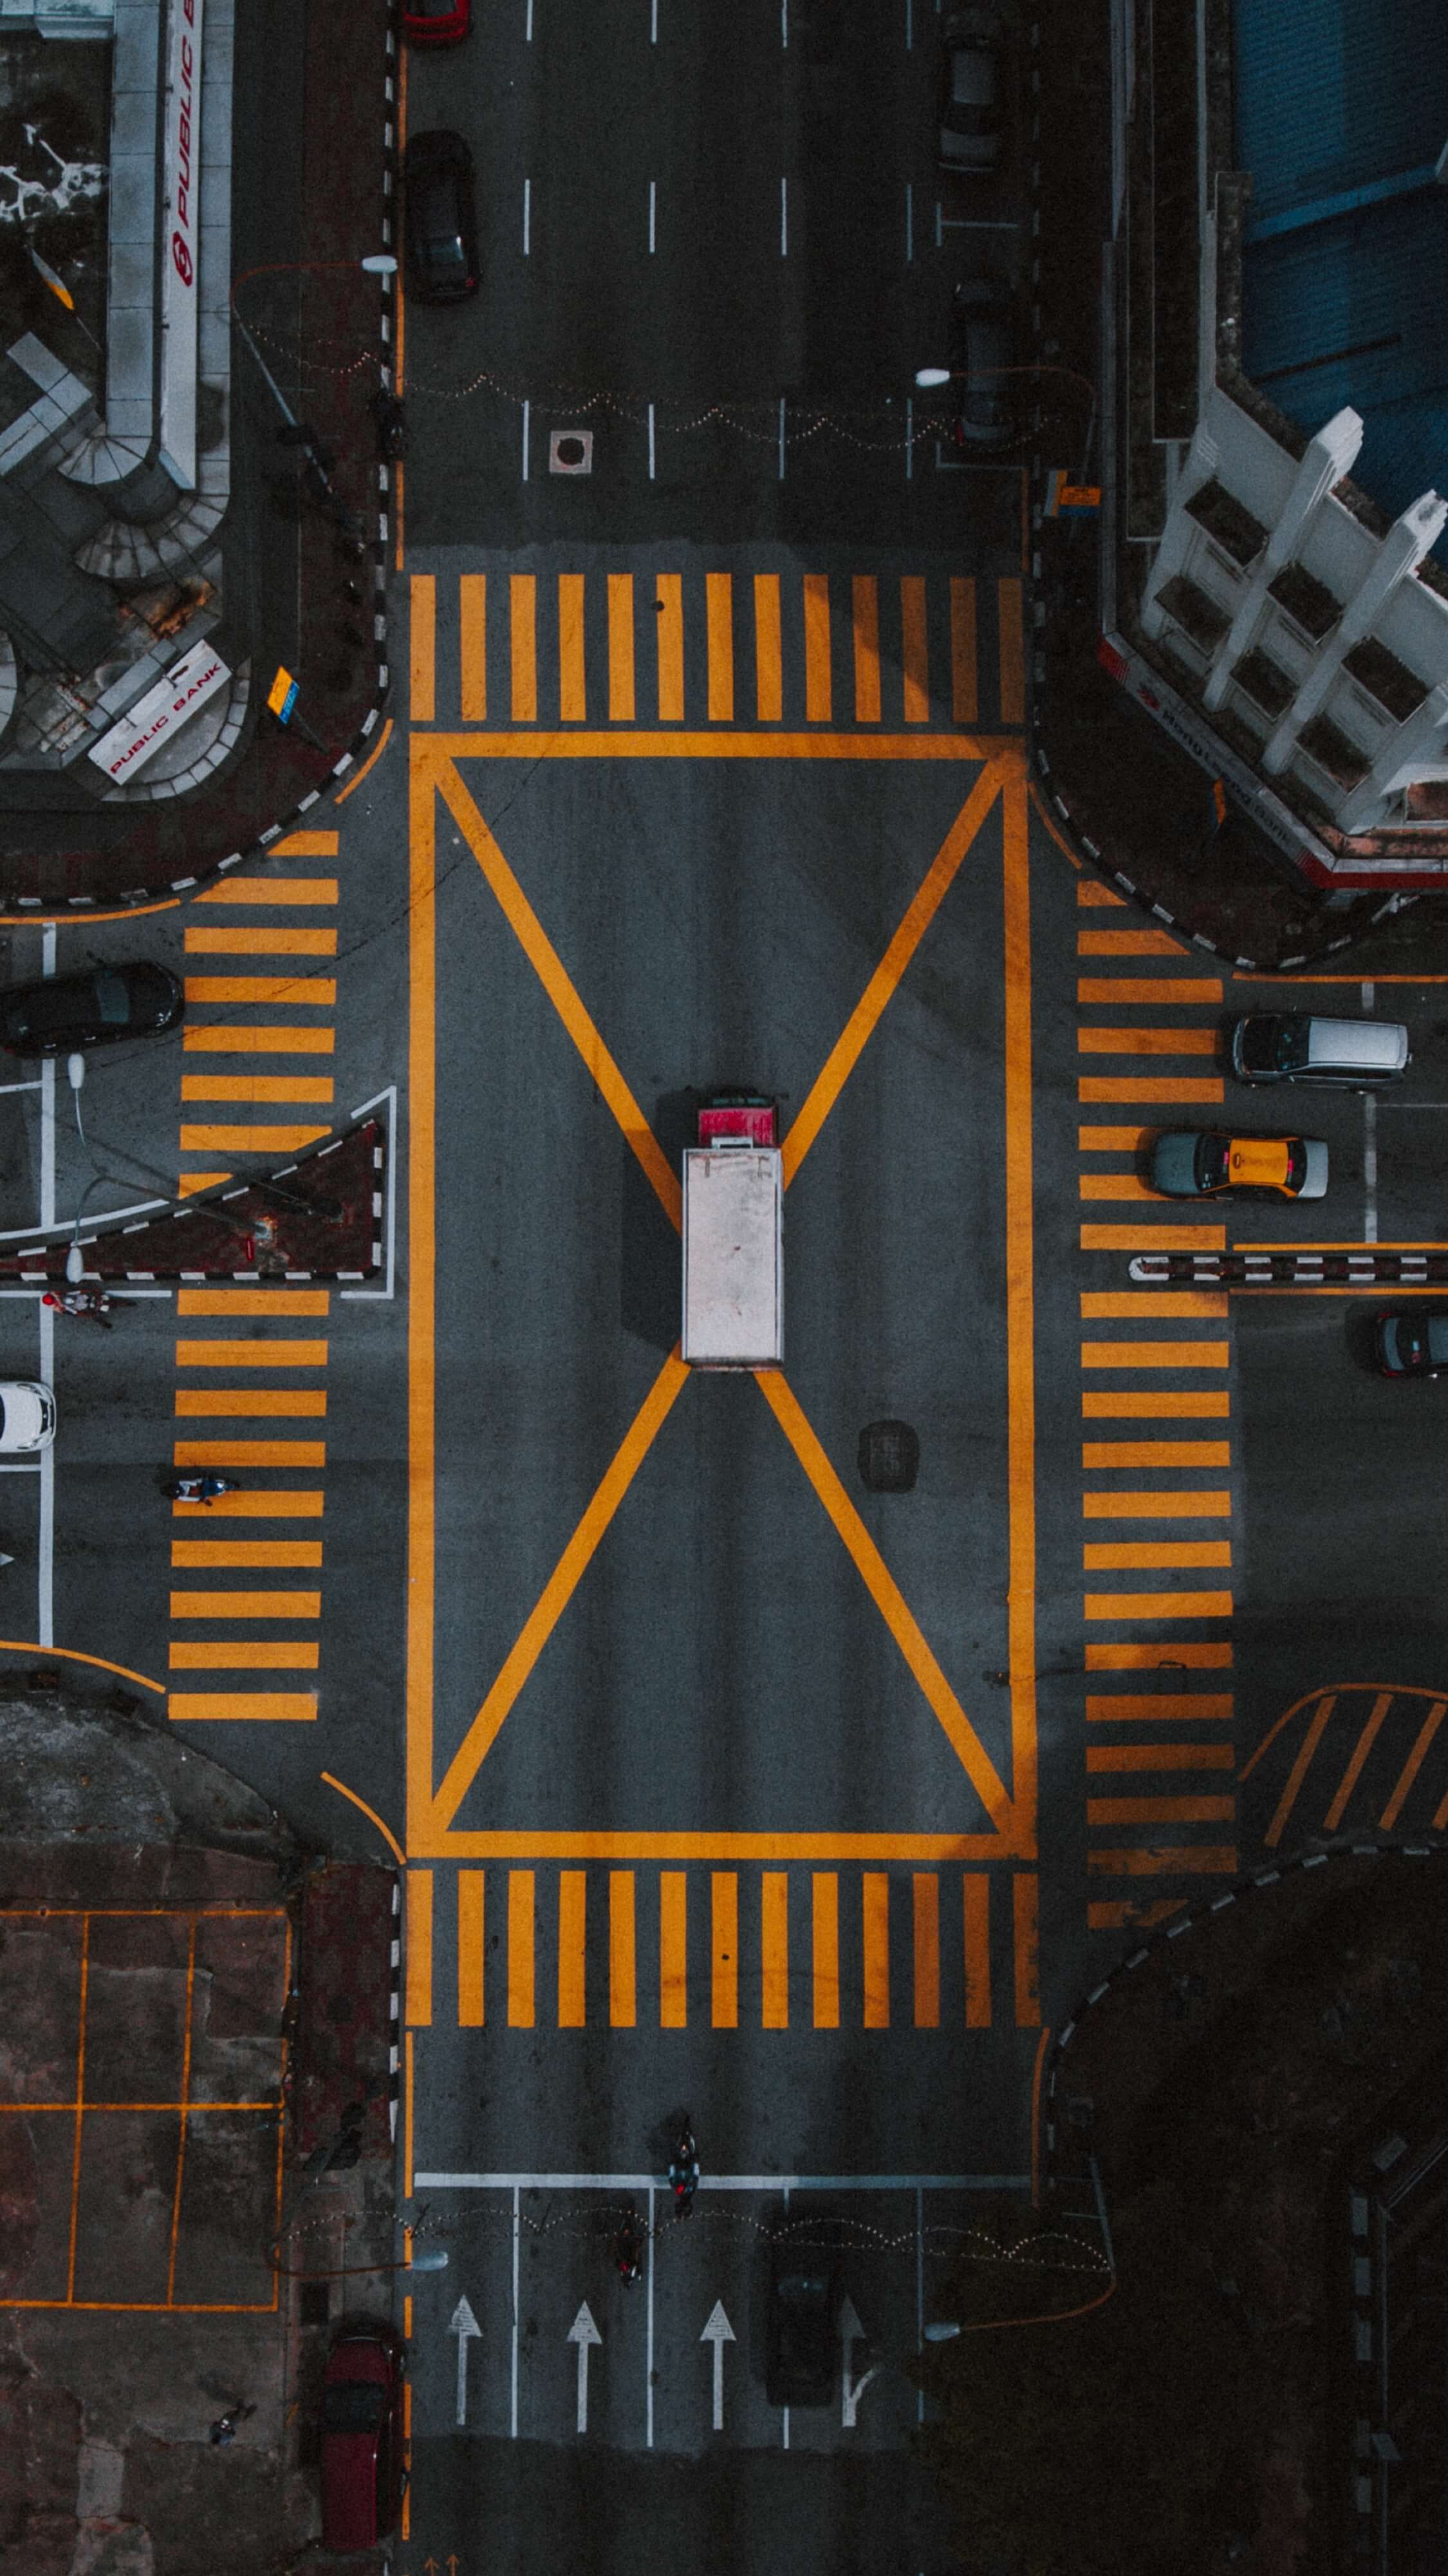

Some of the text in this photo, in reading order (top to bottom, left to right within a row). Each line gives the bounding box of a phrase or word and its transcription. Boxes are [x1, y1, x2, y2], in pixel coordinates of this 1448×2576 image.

[178, 35, 192, 227] PUBLIC
[110, 715, 169, 774] PUBLIC
[172, 663, 222, 711] BANK
